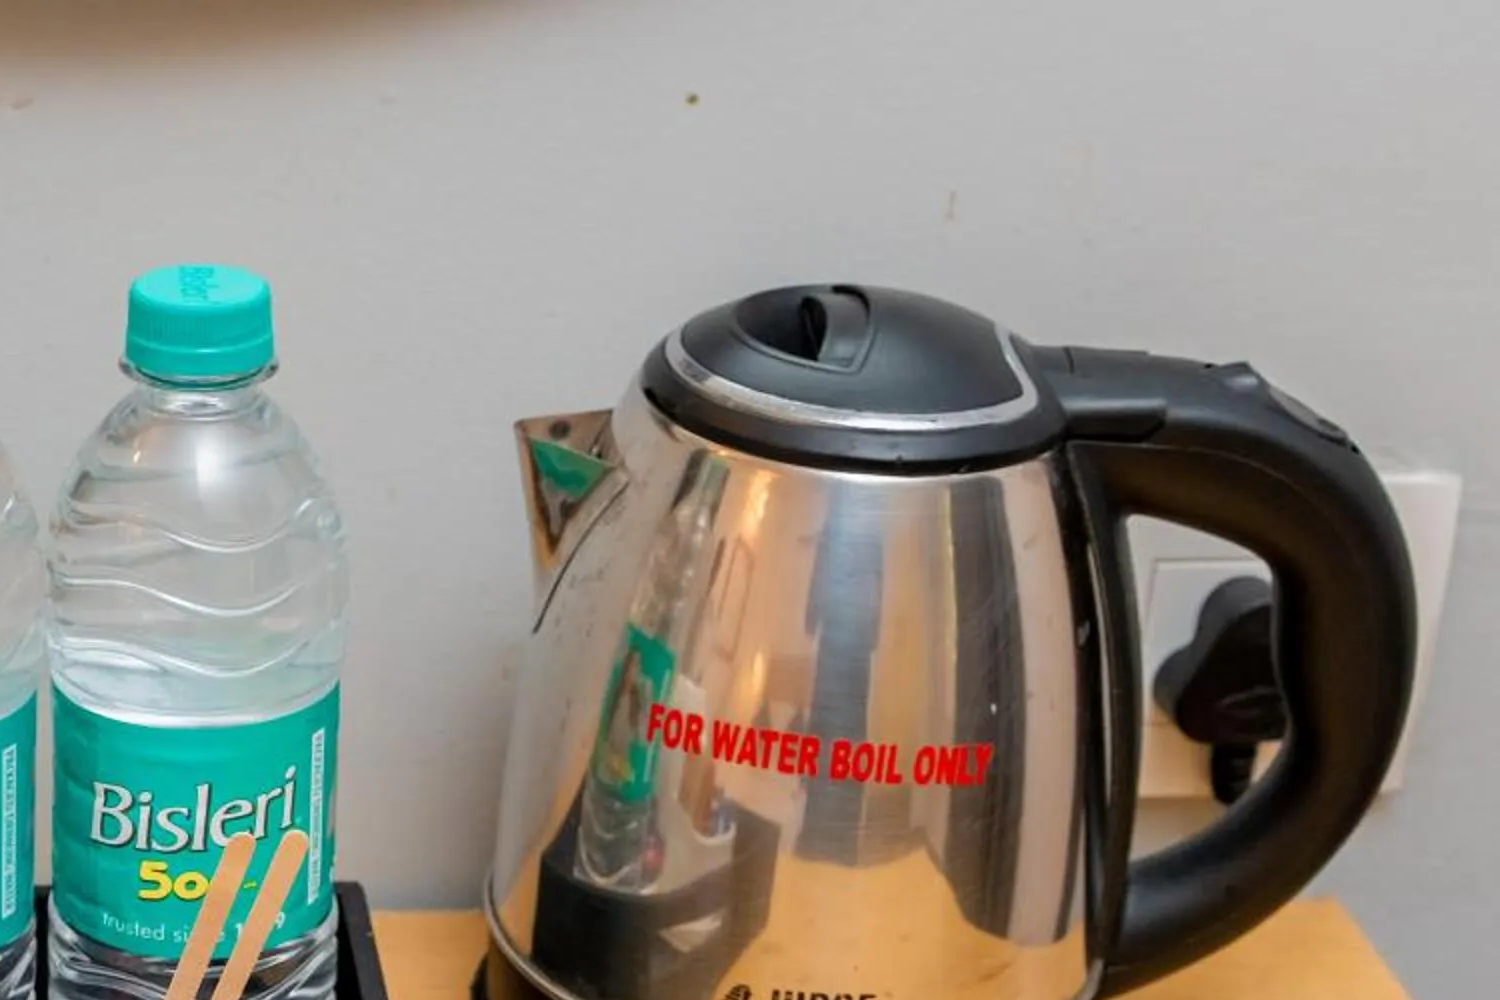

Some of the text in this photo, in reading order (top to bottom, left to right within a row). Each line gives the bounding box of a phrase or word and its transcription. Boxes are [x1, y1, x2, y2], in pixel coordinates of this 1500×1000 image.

[646, 703, 994, 786] FOR WATER BOIL ONLY
[89, 765, 297, 851] Bisleri
[137, 858, 211, 901] 50
[102, 912, 165, 941] trusted
